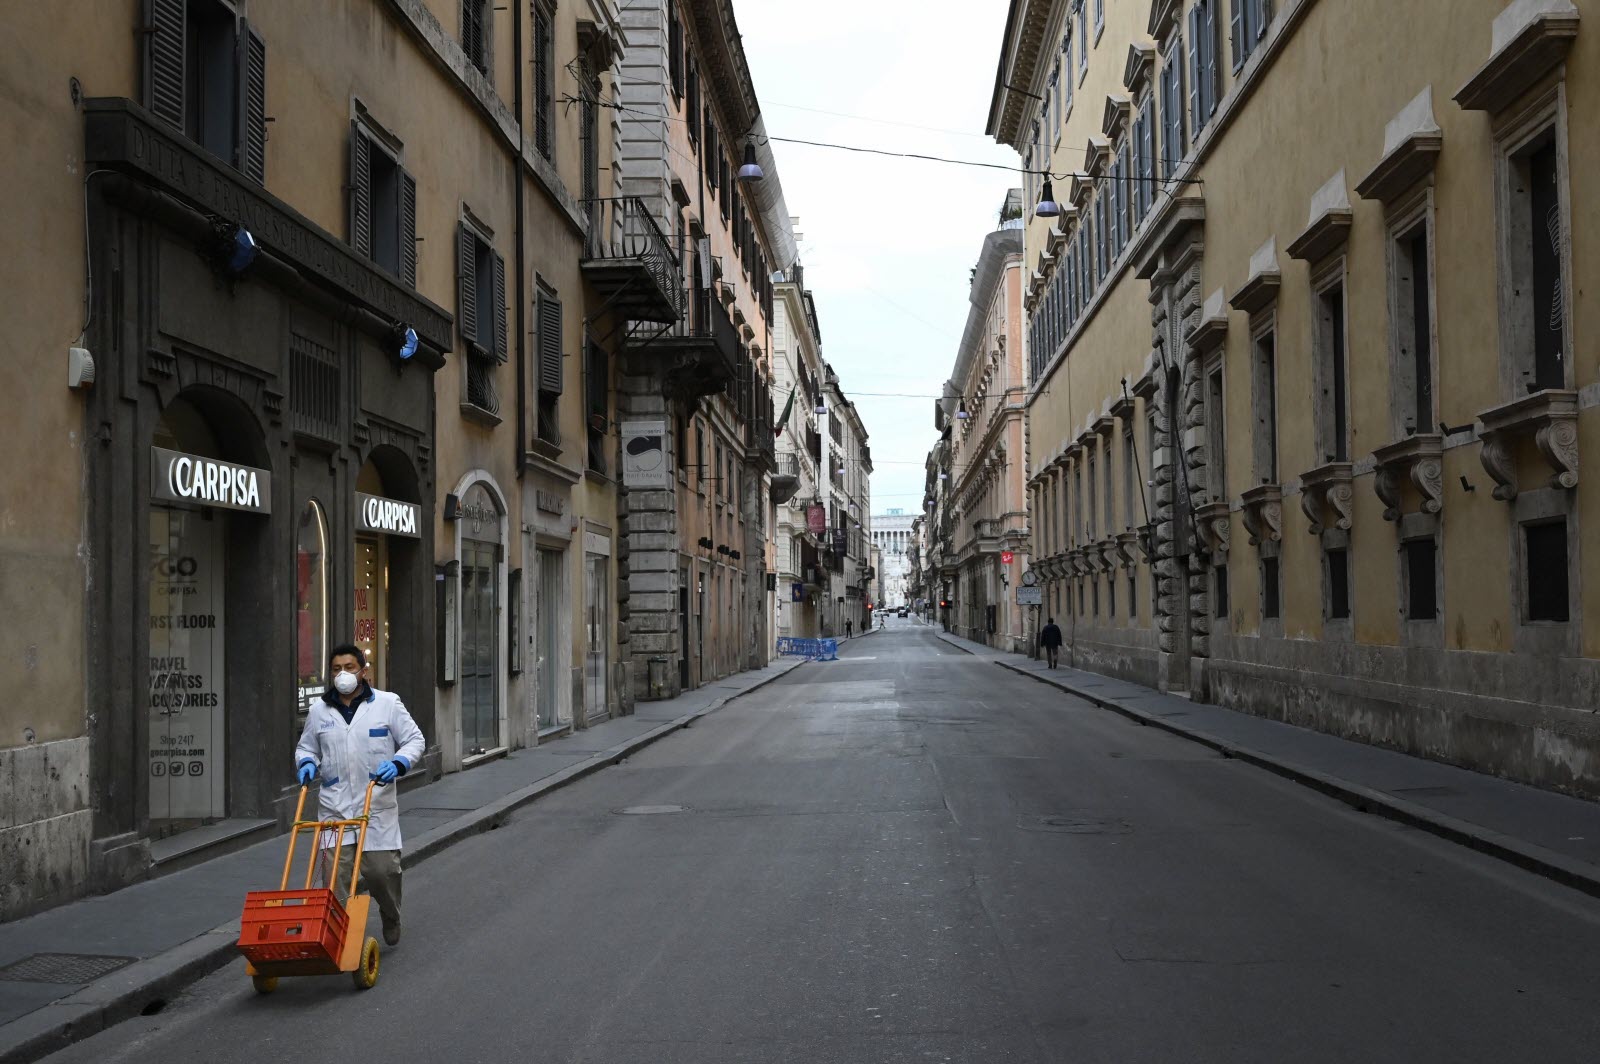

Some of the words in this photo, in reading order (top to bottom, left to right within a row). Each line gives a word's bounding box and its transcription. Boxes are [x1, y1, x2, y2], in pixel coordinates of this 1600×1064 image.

[133, 125, 187, 187] DITTA
[169, 457, 260, 508] CARPISA
[363, 497, 416, 534] CARPISA
[177, 614, 216, 629] FLOOR
[150, 748, 205, 758] gocarpisa.com
[160, 735, 176, 746] Shop
